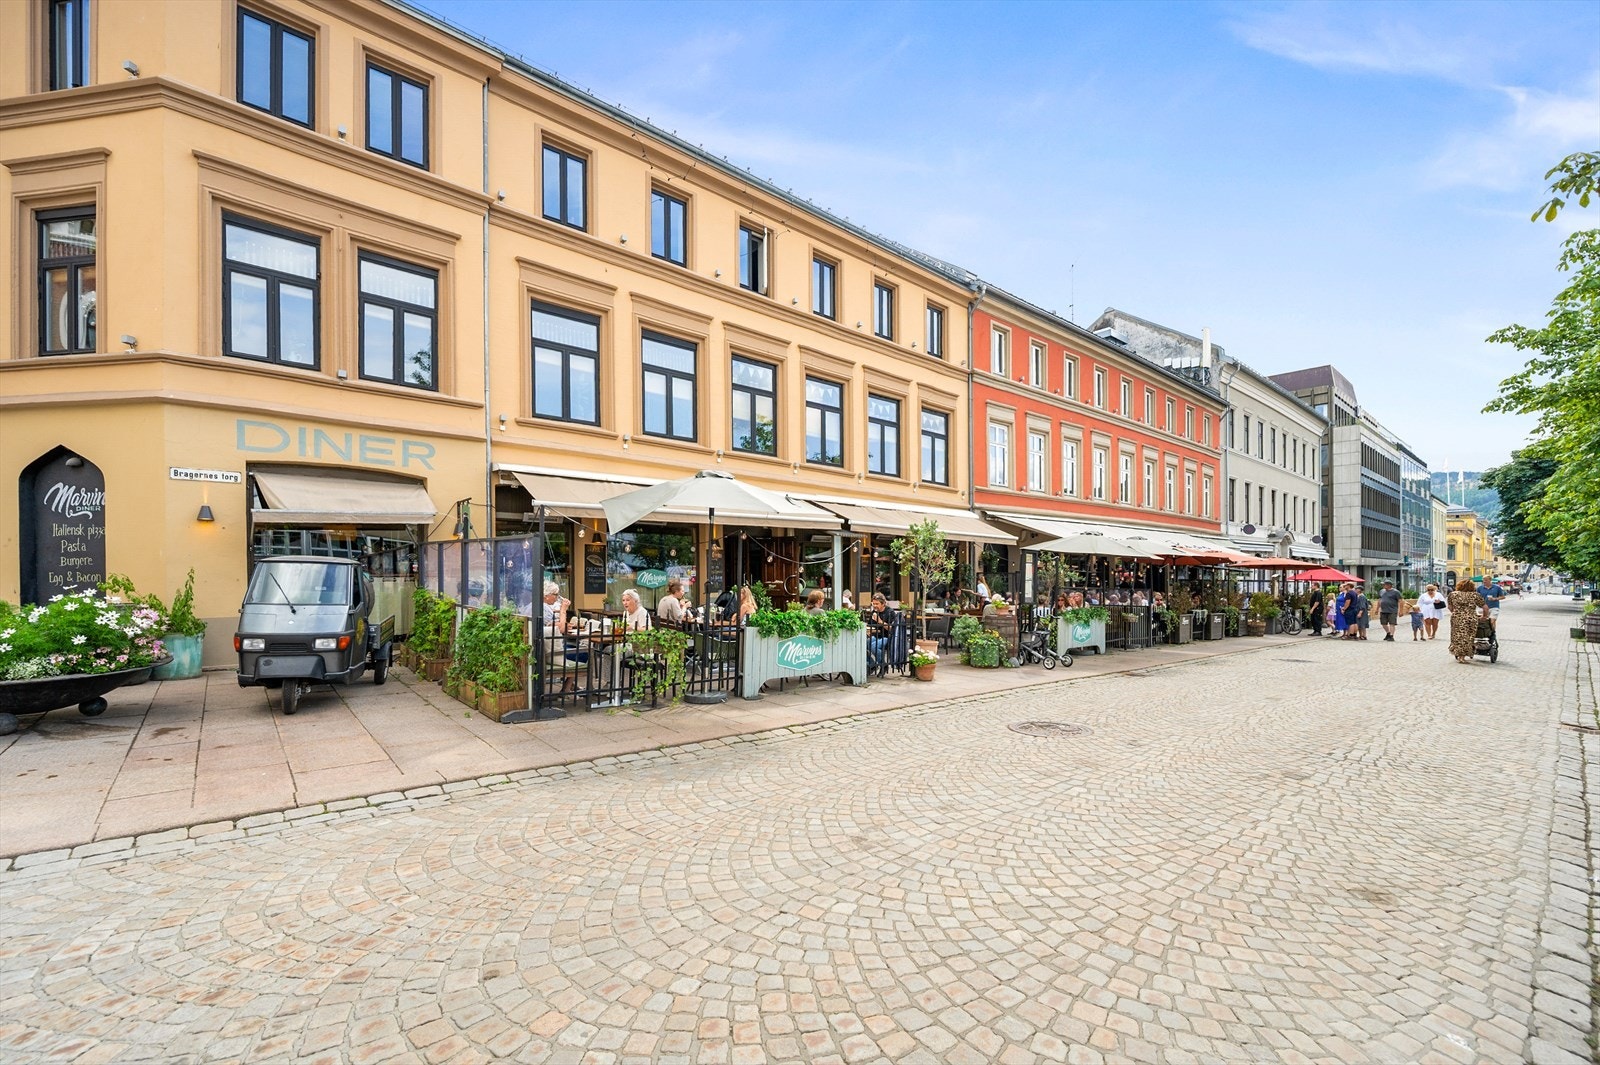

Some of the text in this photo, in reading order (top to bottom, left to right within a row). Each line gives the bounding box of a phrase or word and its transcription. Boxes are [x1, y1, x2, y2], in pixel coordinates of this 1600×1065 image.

[236, 419, 436, 470] DINER
[173, 469, 239, 482] Bragernes torg
[43, 482, 106, 519] Marvin
[52, 523, 85, 537] Italiensk
[60, 537, 87, 553] Pasta
[59, 556, 93, 569] Burgere
[48, 571, 102, 587] Egg & Bacon
[778, 641, 822, 665] Marvins
